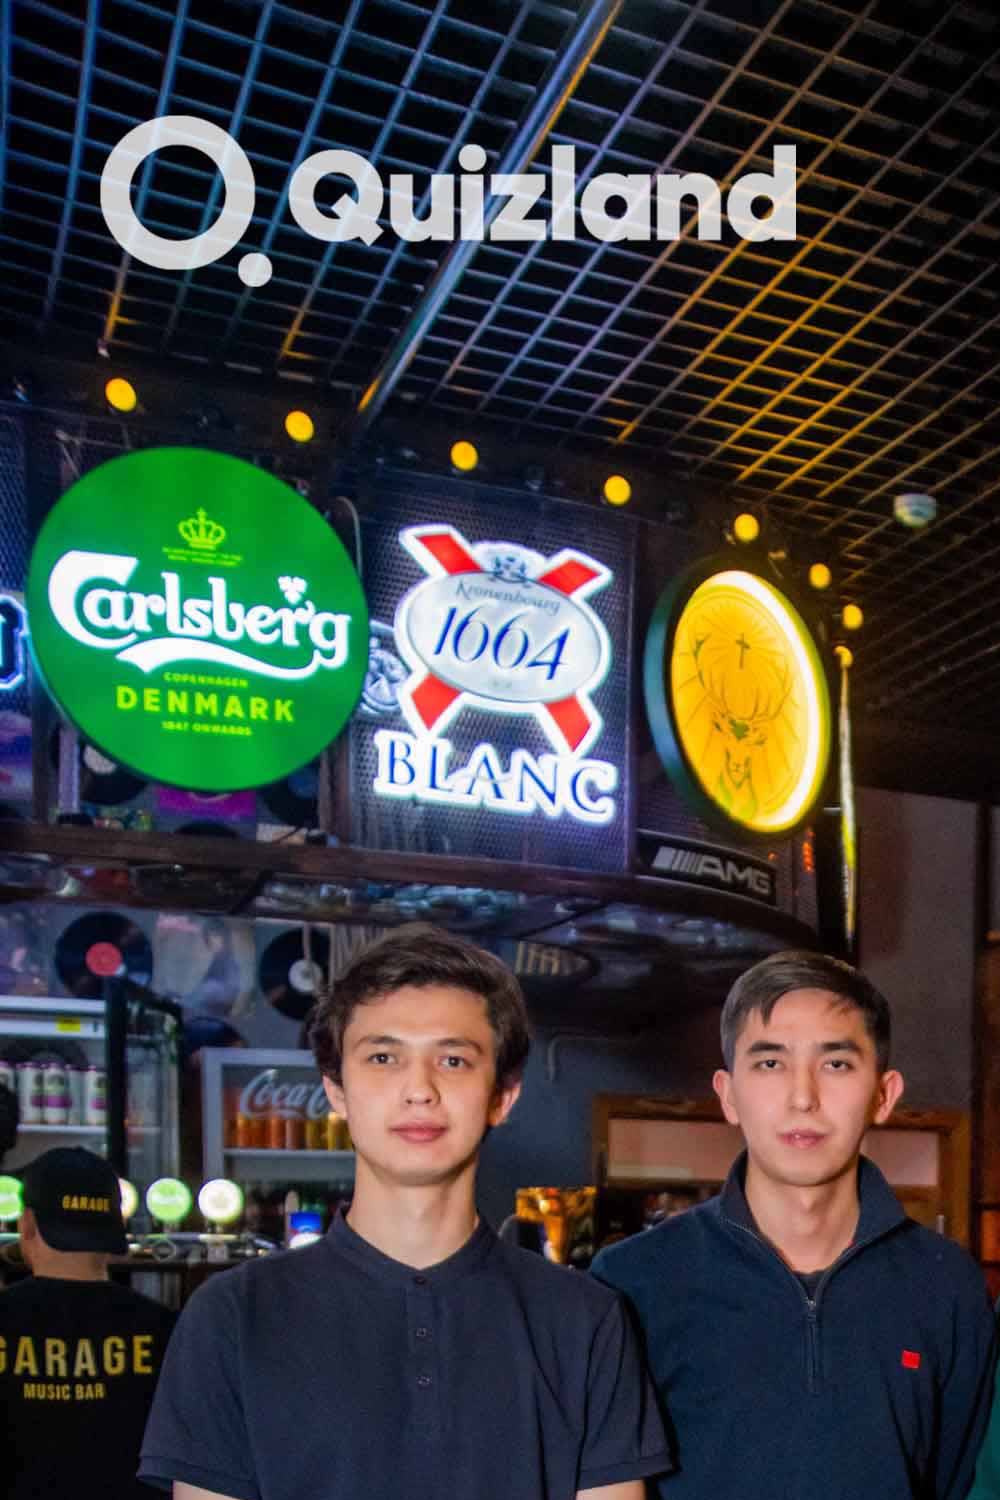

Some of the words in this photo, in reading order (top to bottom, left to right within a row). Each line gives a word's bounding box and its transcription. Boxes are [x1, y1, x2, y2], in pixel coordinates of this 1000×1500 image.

[47, 549, 352, 677] Carlsberg
[434, 607, 570, 680] 1664
[116, 686, 294, 722] DENMARK
[382, 735, 612, 818] BLANC
[62, 1195, 110, 1212] GARAGE
[23, 1383, 70, 1400] MUSIC
[75, 1383, 105, 1400] BAR
